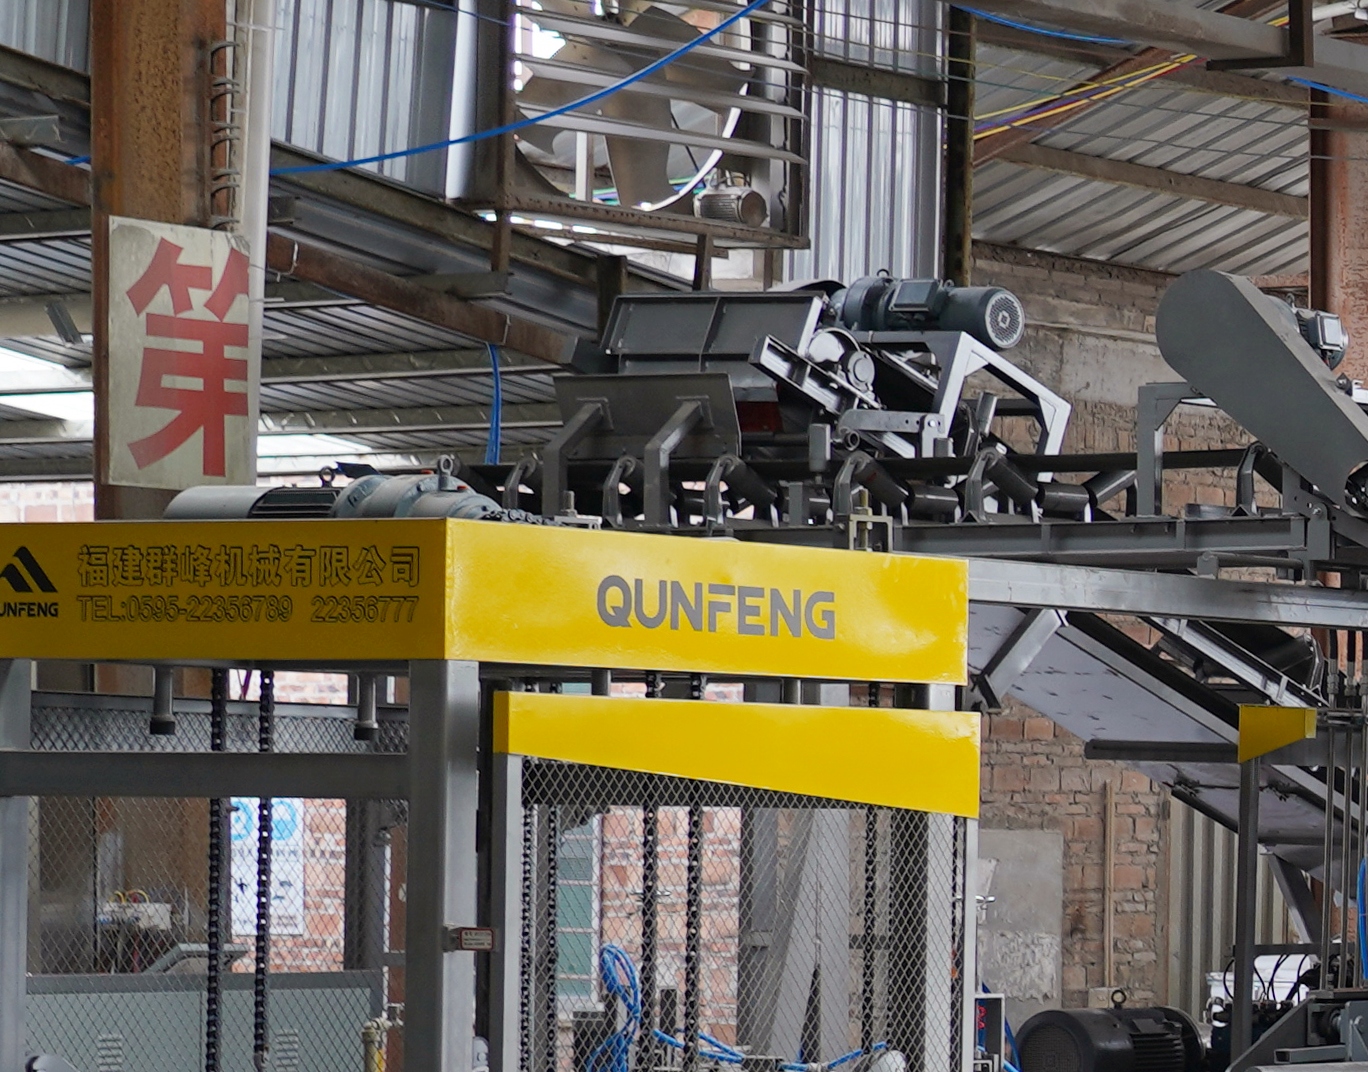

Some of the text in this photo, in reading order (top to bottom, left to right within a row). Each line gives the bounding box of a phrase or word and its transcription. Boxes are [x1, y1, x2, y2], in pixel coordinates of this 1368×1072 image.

[126, 237, 250, 477] 第
[77, 544, 420, 587] 福建群峰机械有限公司
[0, 602, 59, 617] UNFENG
[77, 595, 419, 622] TEL:0595-22356789 22356777
[597, 575, 835, 640] QUNFENG
